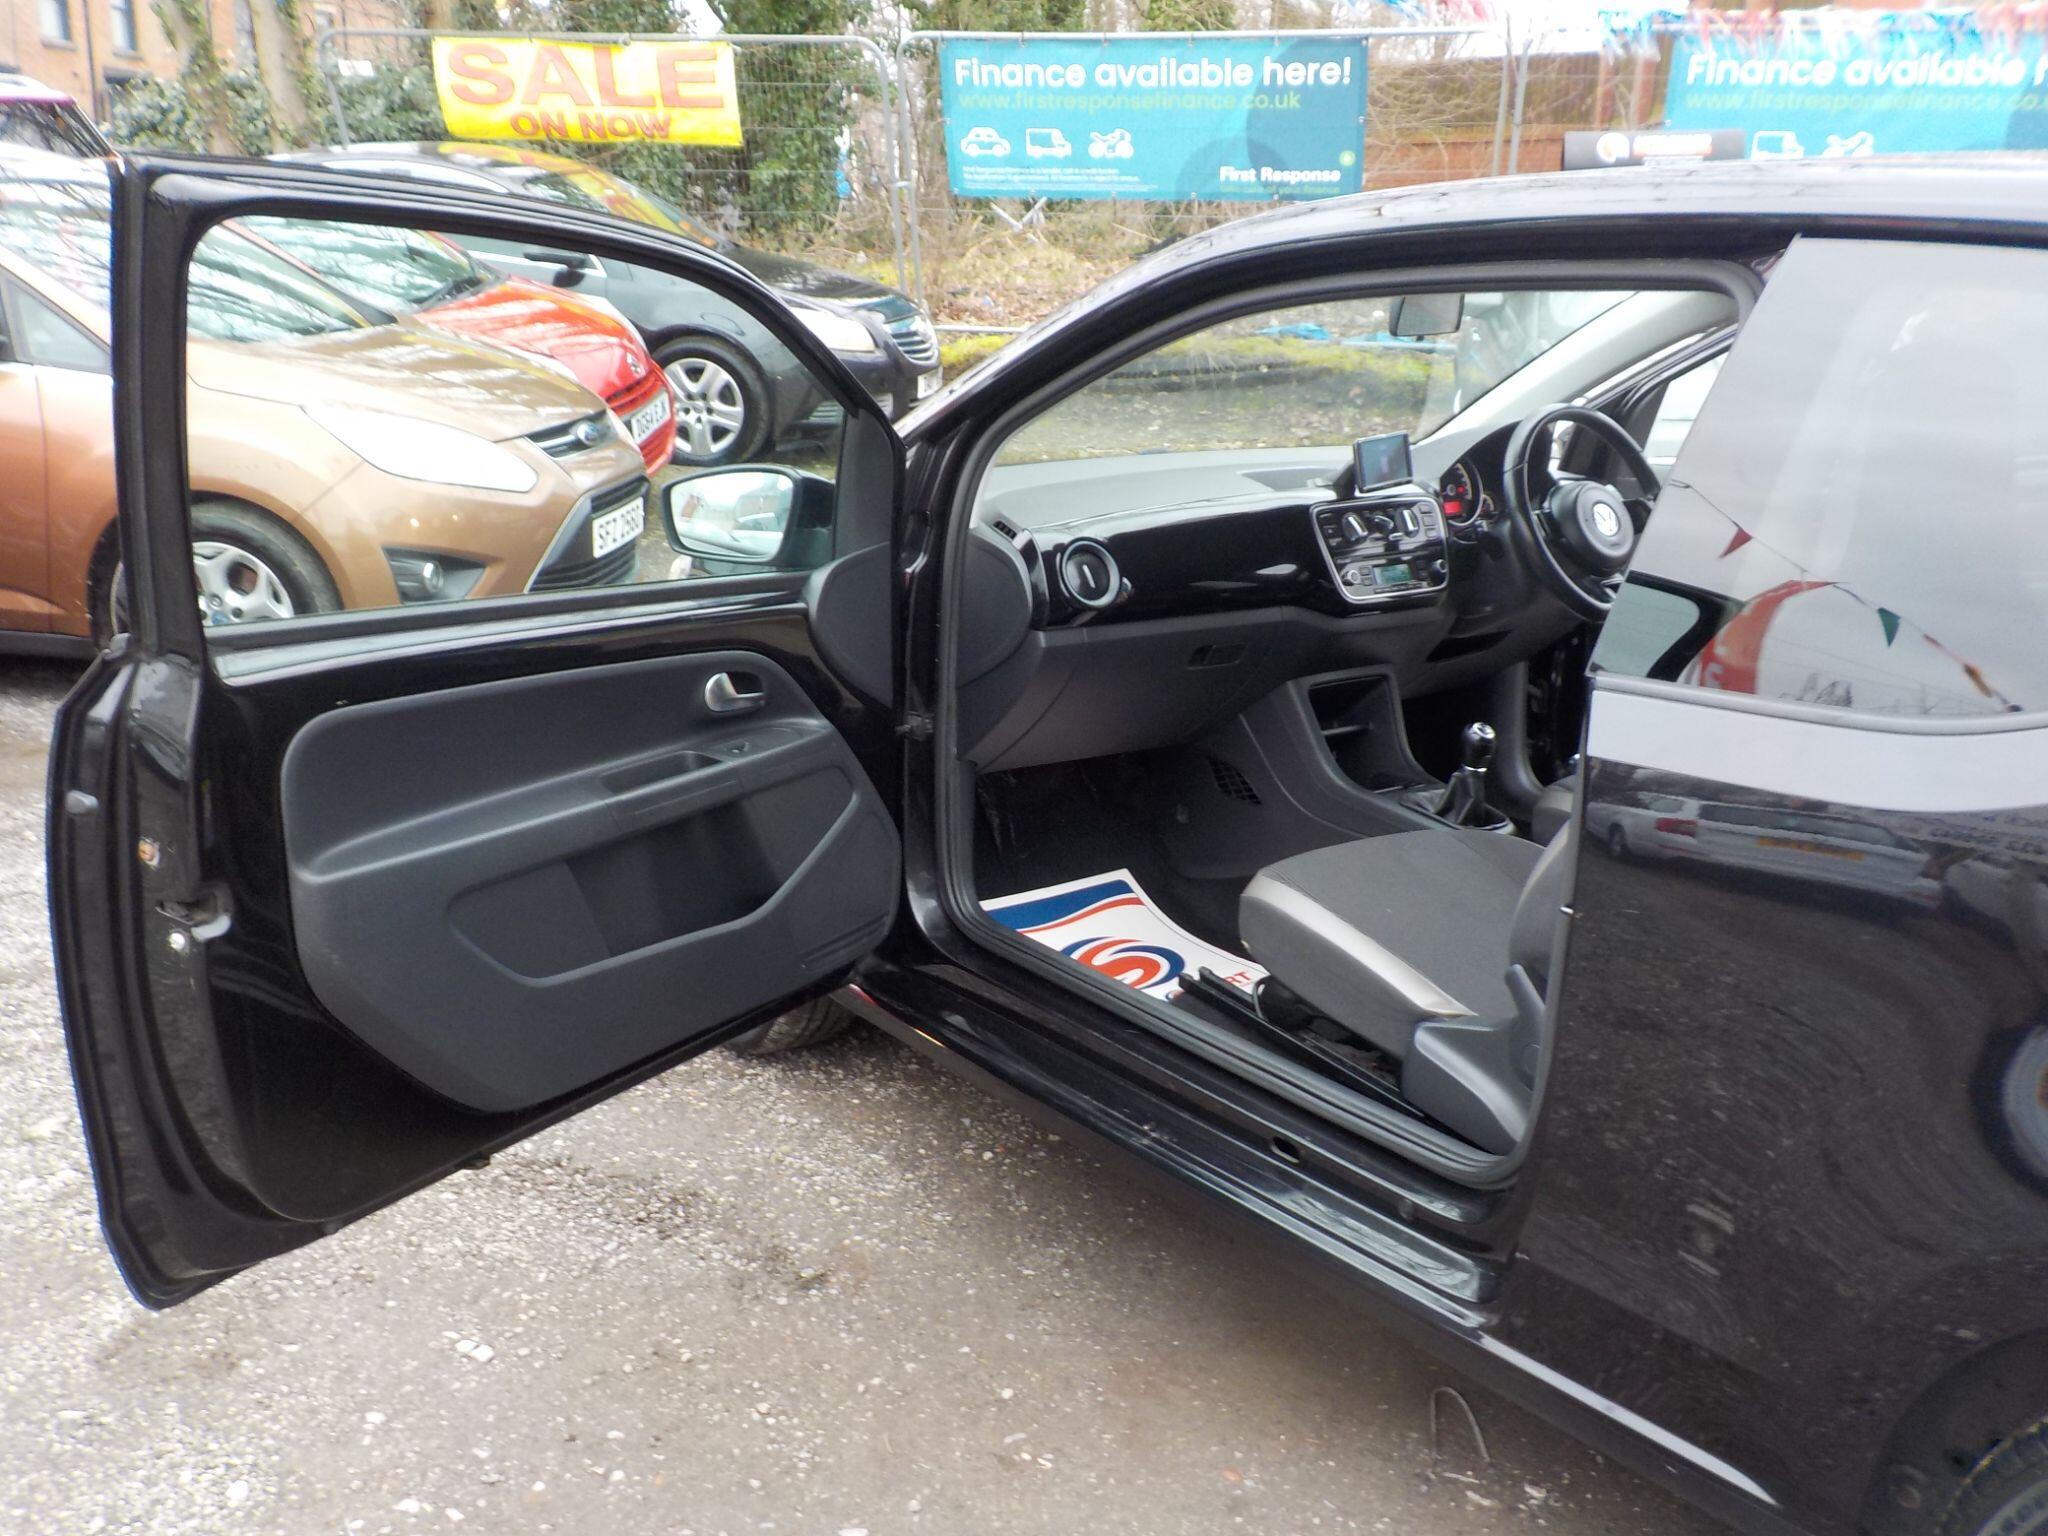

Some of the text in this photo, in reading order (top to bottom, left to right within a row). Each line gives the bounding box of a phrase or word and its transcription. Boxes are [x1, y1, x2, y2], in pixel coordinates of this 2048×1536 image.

[449, 42, 724, 108] SALE
[955, 56, 1351, 88] Finance available here!
[1687, 53, 1836, 86] Finance
[1844, 52, 2026, 86] available
[510, 112, 671, 139] ON NOW
[1219, 166, 1342, 184] First Response
